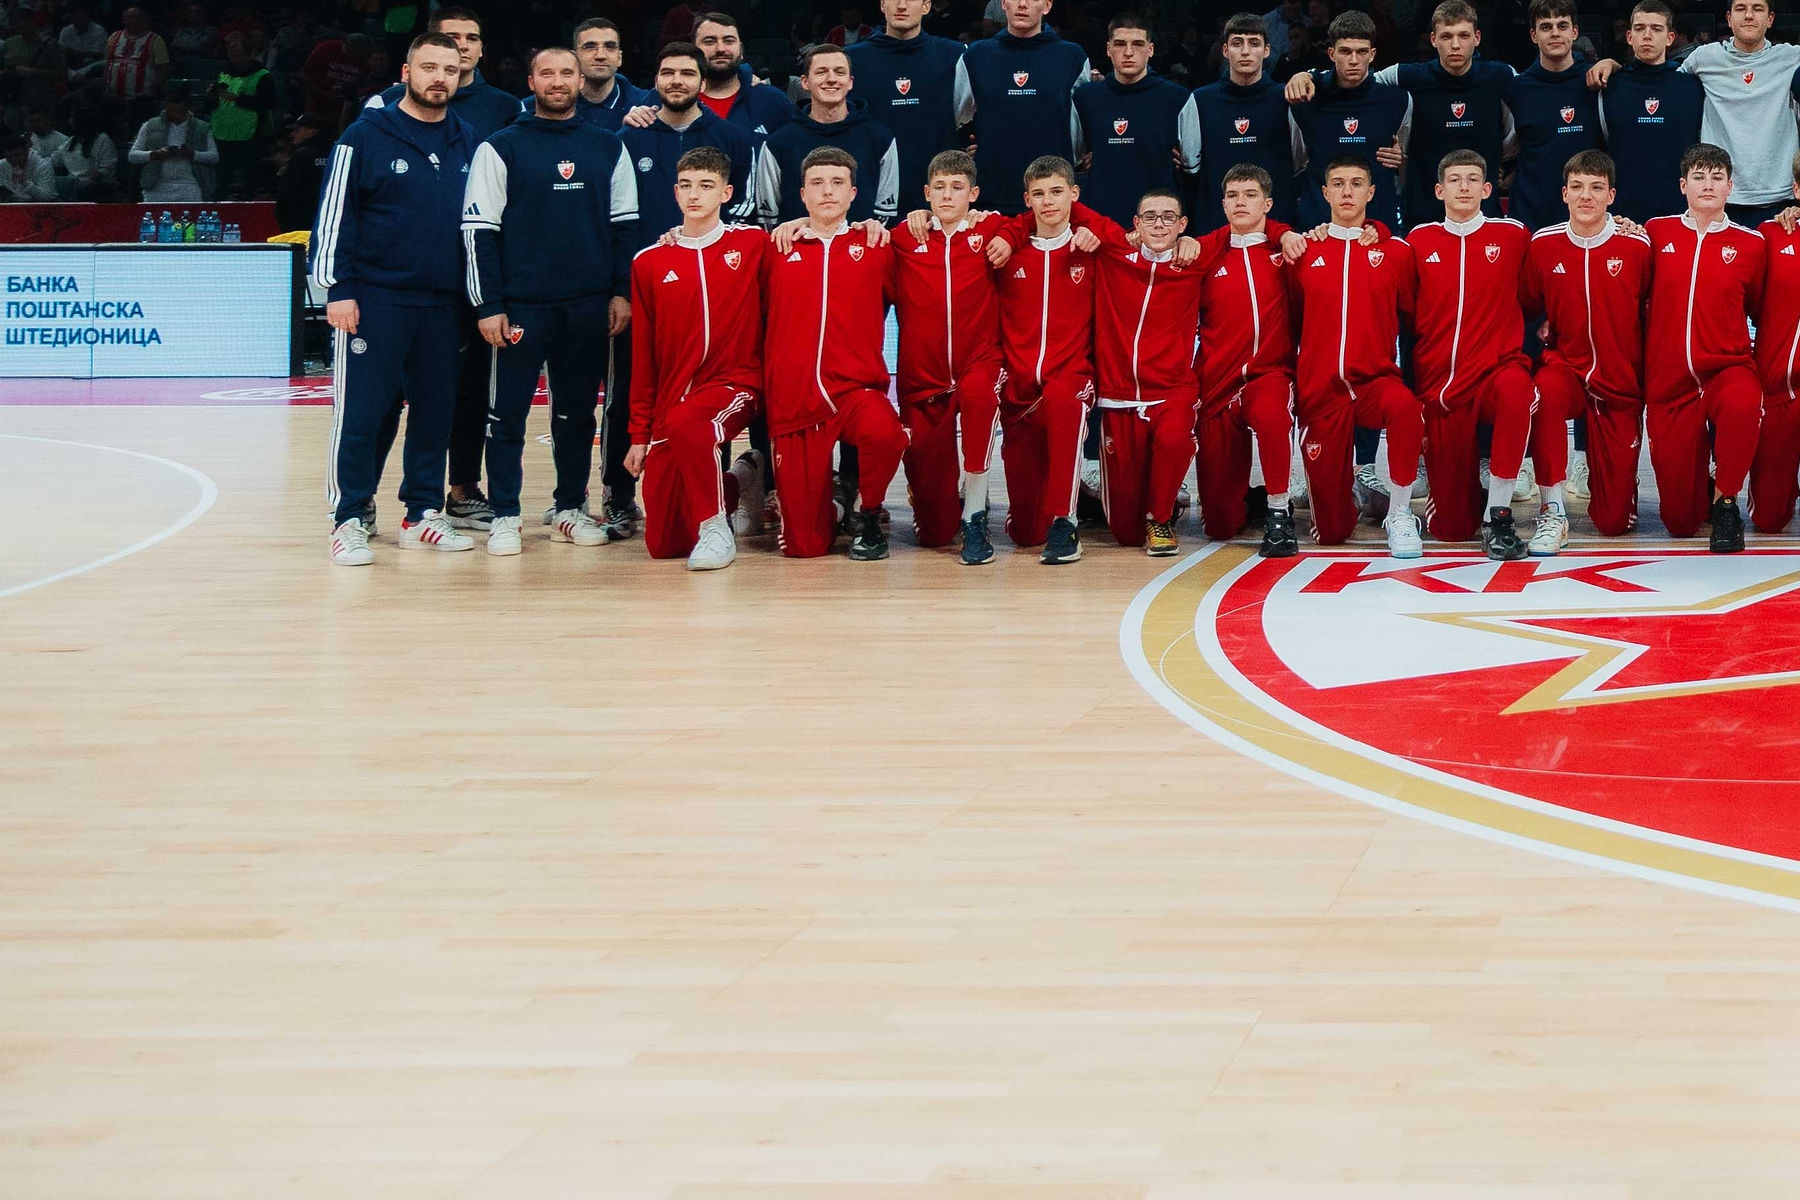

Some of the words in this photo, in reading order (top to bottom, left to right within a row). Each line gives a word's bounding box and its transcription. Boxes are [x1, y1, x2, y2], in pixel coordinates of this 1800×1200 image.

[7, 276, 79, 292] БАНКА
[7, 301, 144, 318] ПОШТАНСКА
[6, 327, 162, 347] ШТЕДИОНИЦА
[1298, 559, 1667, 594] KK
